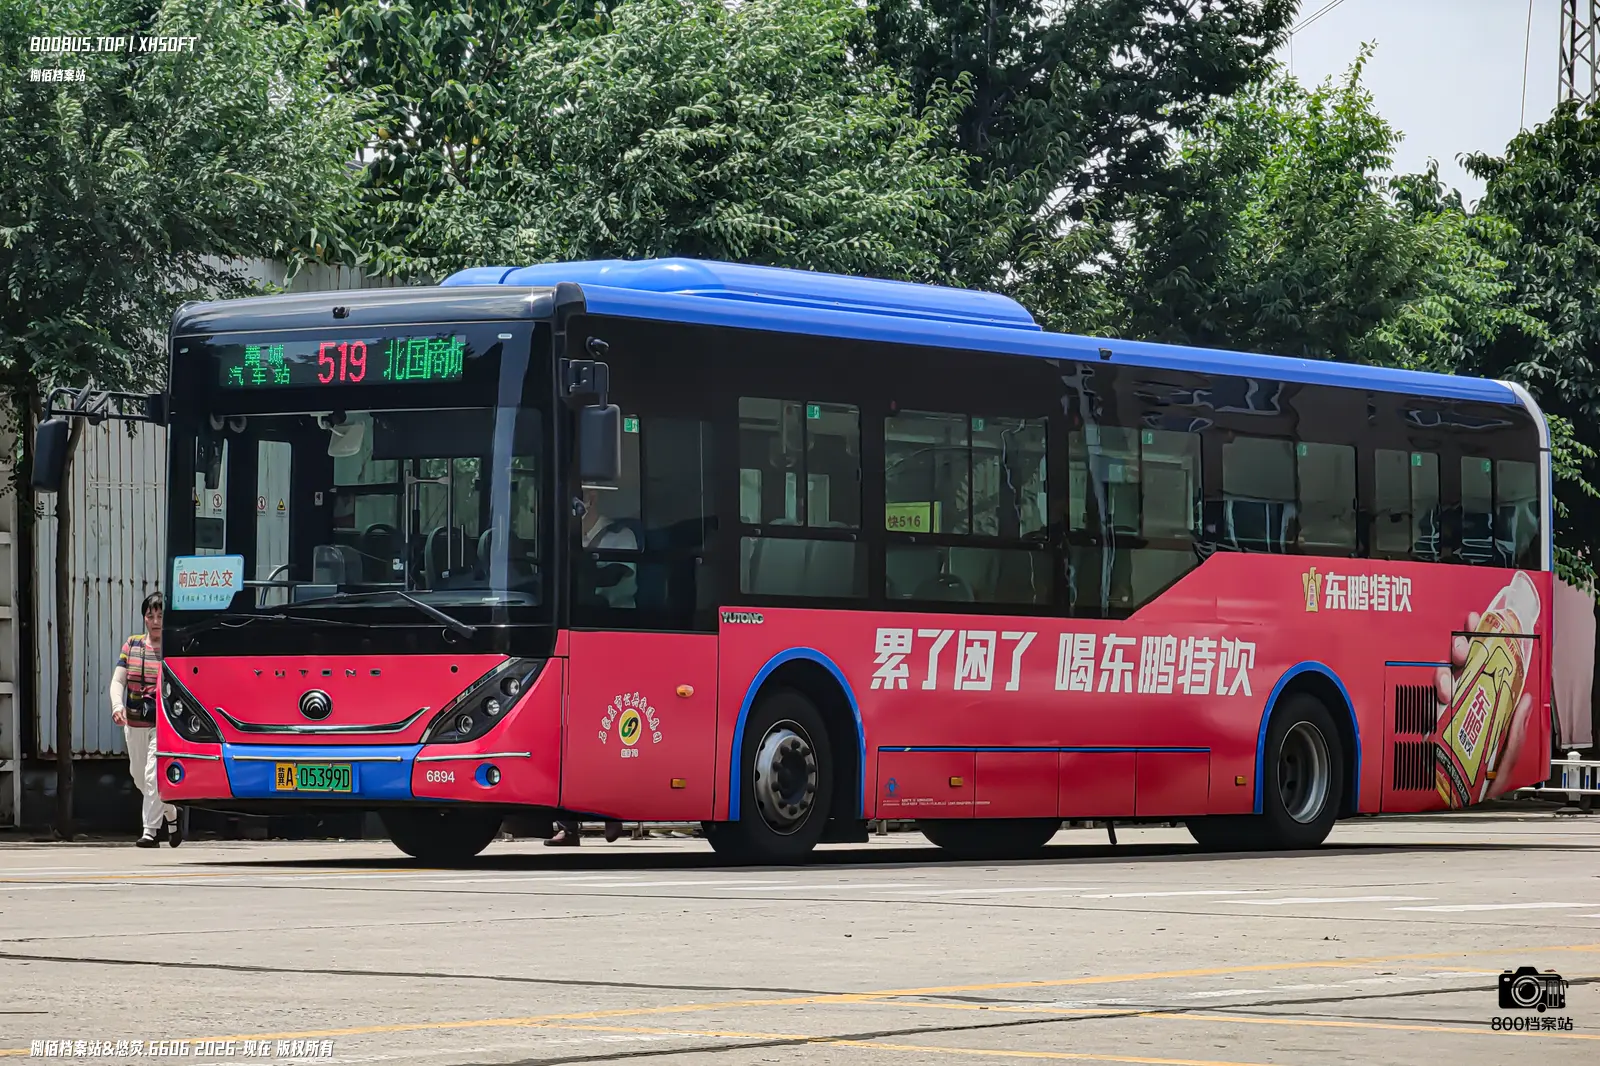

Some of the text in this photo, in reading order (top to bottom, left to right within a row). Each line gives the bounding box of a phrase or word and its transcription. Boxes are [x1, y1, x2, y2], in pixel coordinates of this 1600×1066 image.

[317, 340, 367, 383] 519
[228, 364, 291, 385] 汽车站
[888, 515, 921, 529] 快516
[178, 569, 234, 588] 响应式公交
[1325, 571, 1412, 612] 东鹏特饮
[721, 611, 765, 624] YUTONG
[870, 627, 1256, 697] 累了困了 喝东鹏特饮
[254, 668, 381, 678] YUTONG
[426, 770, 455, 783] 6894
